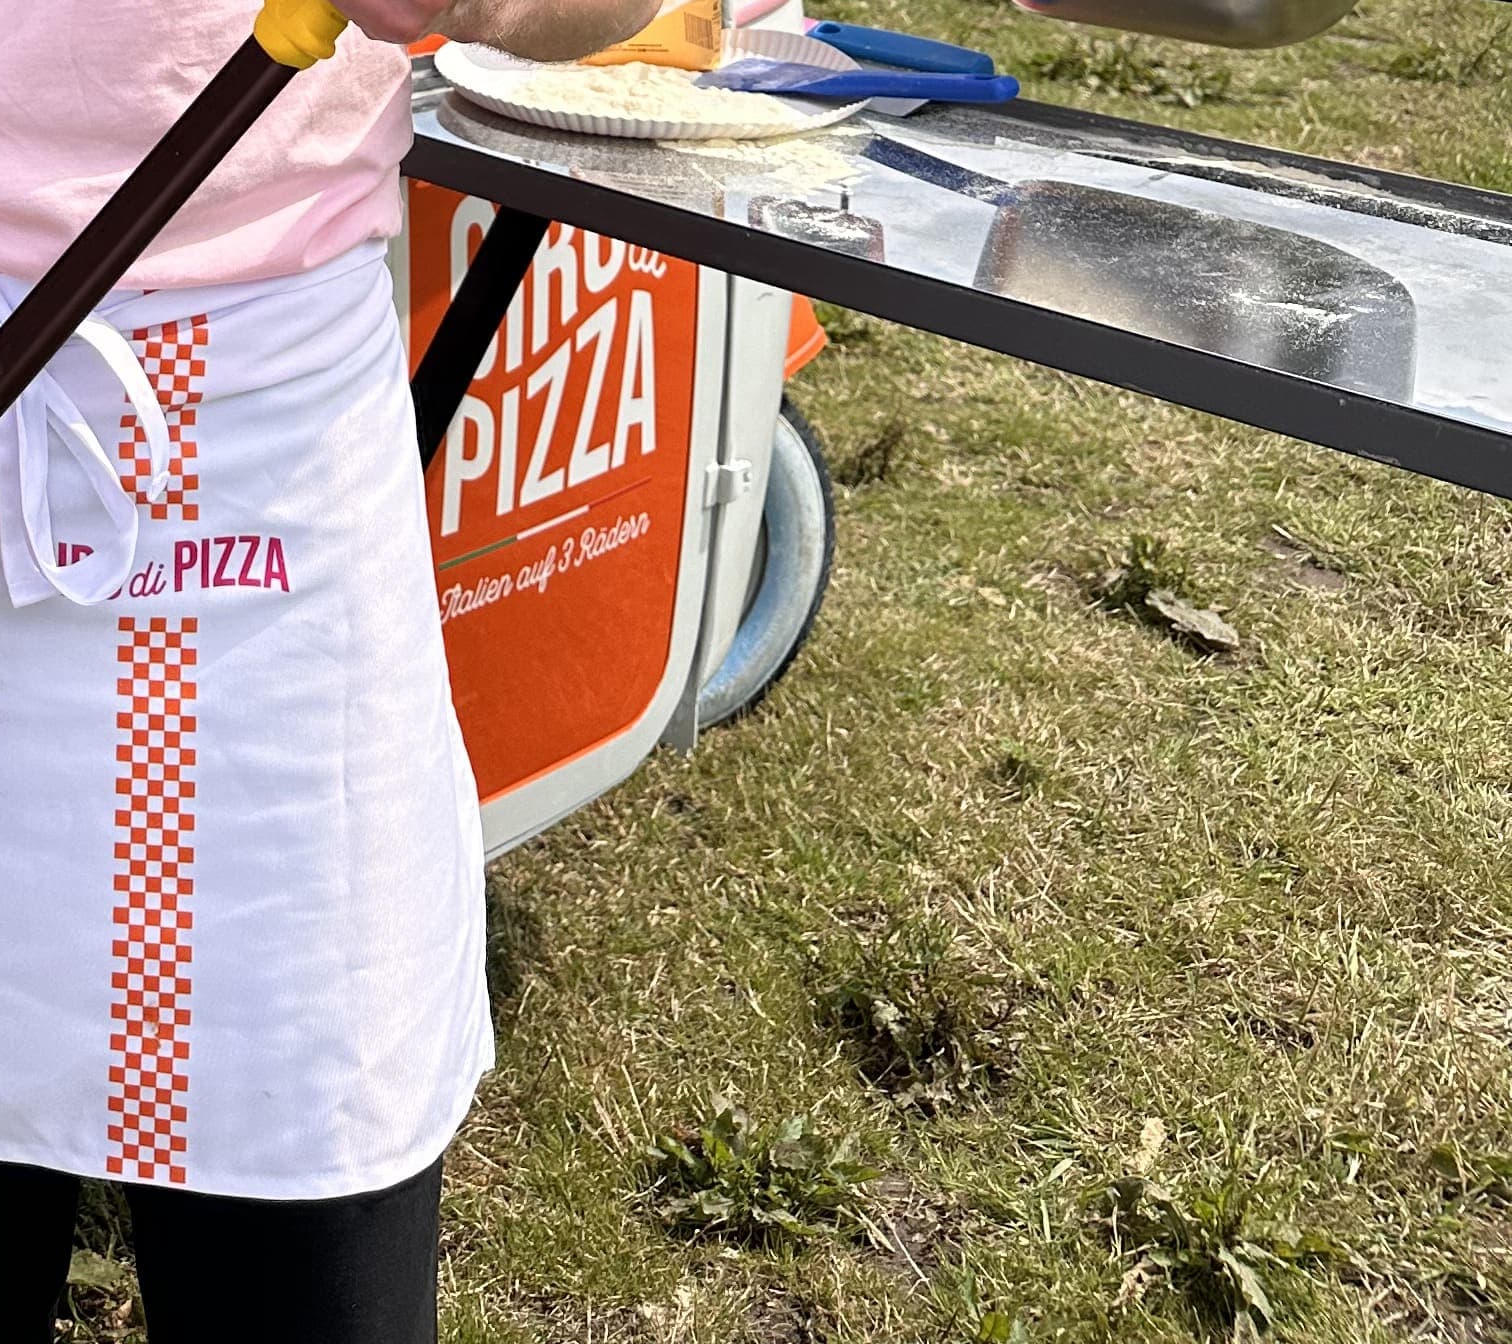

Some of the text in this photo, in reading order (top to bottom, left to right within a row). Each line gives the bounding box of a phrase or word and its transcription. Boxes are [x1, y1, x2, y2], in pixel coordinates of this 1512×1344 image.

[441, 289, 656, 537] PIZZA
[129, 562, 167, 598] di
[174, 536, 290, 593] PIZZA
[441, 511, 650, 624] Italien auf 3 Rädern
